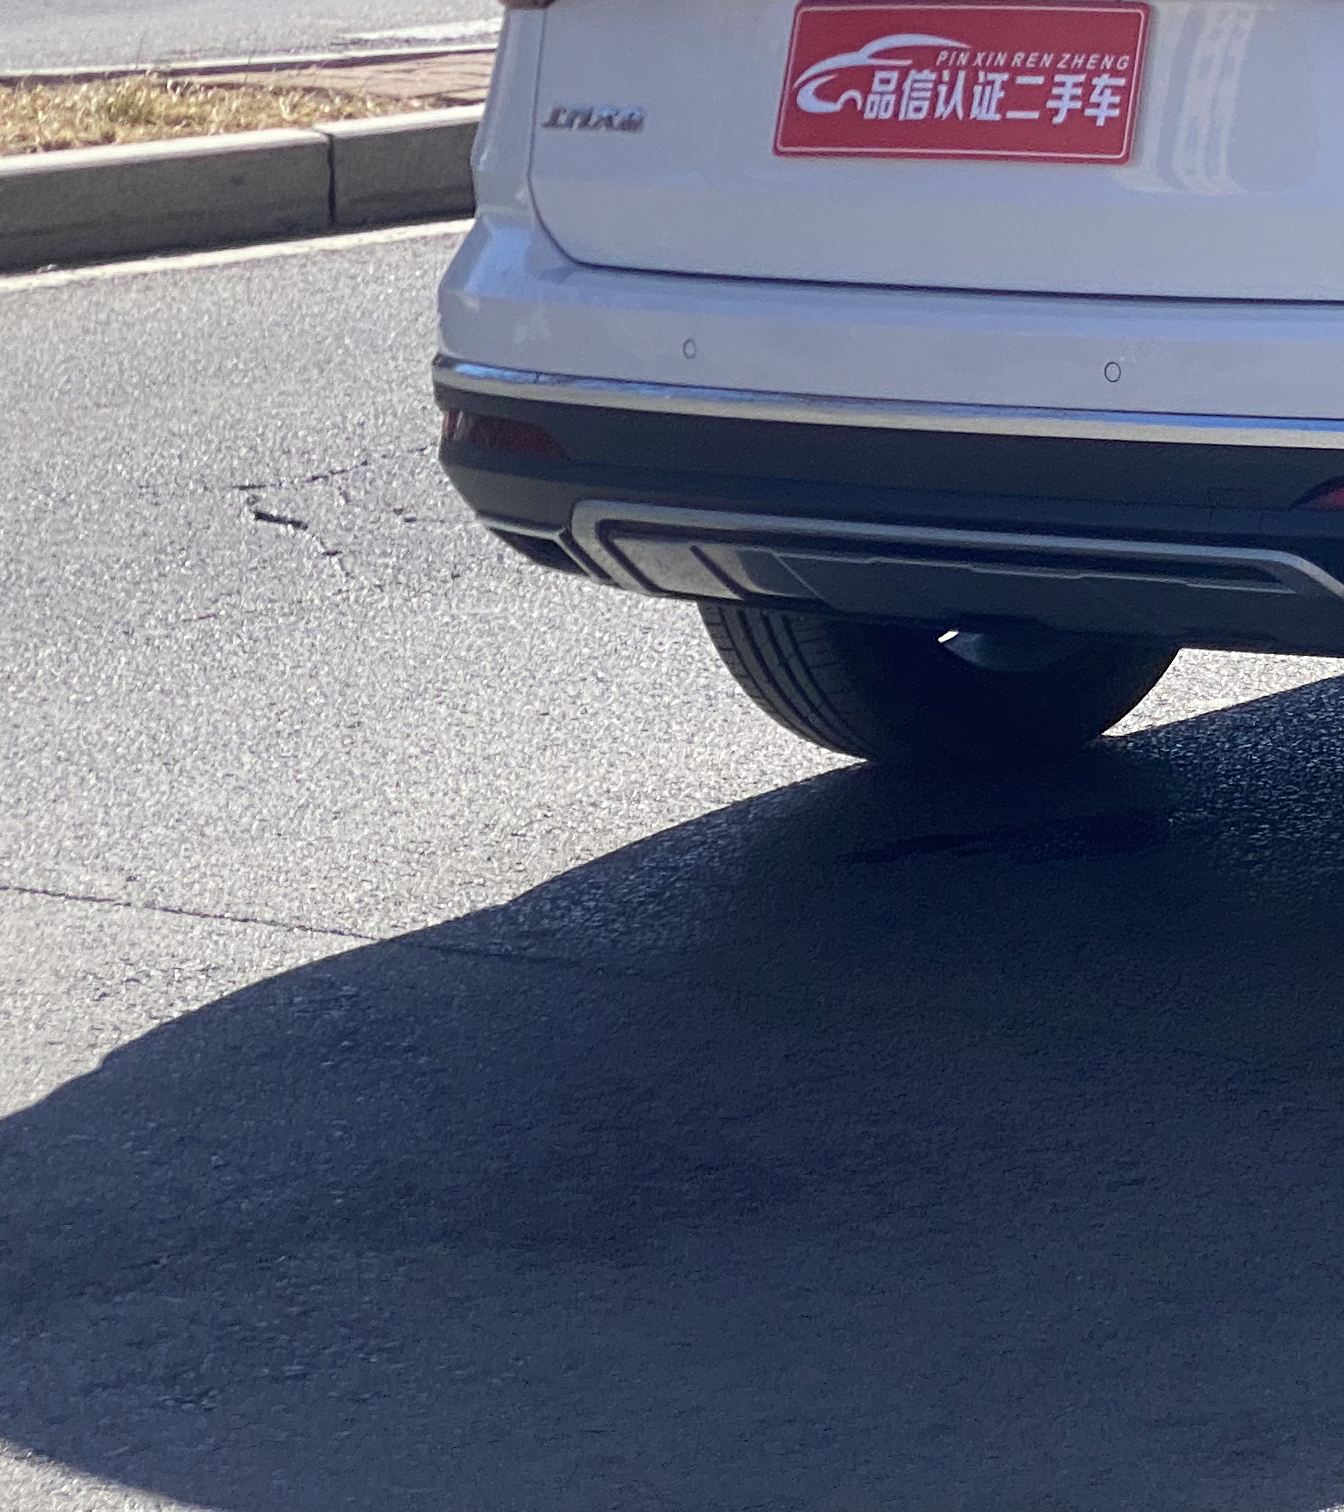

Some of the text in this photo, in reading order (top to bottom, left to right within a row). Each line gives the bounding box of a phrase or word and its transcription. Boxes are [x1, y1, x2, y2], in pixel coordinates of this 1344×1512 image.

[935, 50, 1130, 72] PIN XIN REN ZHENG
[863, 68, 1127, 127] 品信认证二手车
